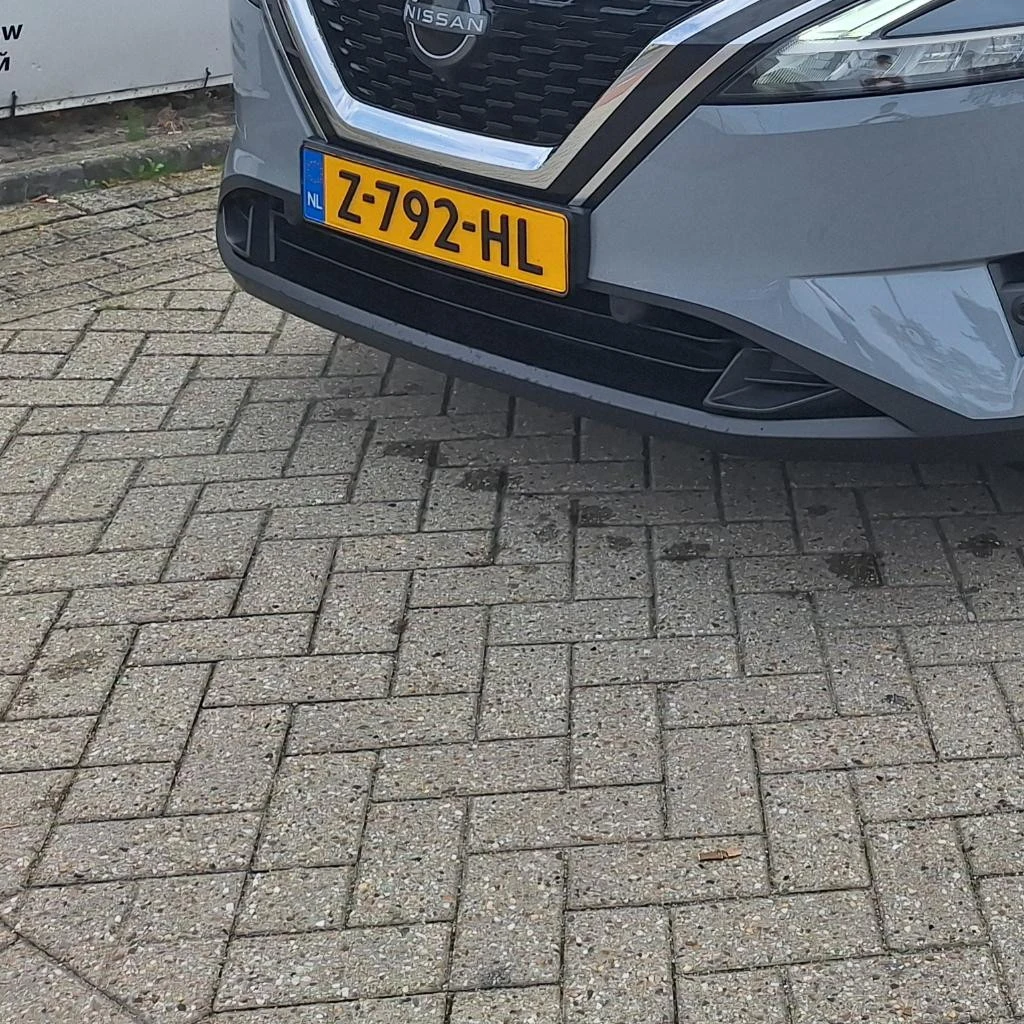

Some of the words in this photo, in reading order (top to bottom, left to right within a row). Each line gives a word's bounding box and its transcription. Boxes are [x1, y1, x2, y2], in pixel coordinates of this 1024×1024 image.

[403, 3, 484, 33] NISSAN
[307, 191, 324, 210] NL
[337, 169, 544, 276] Z-792-HL
